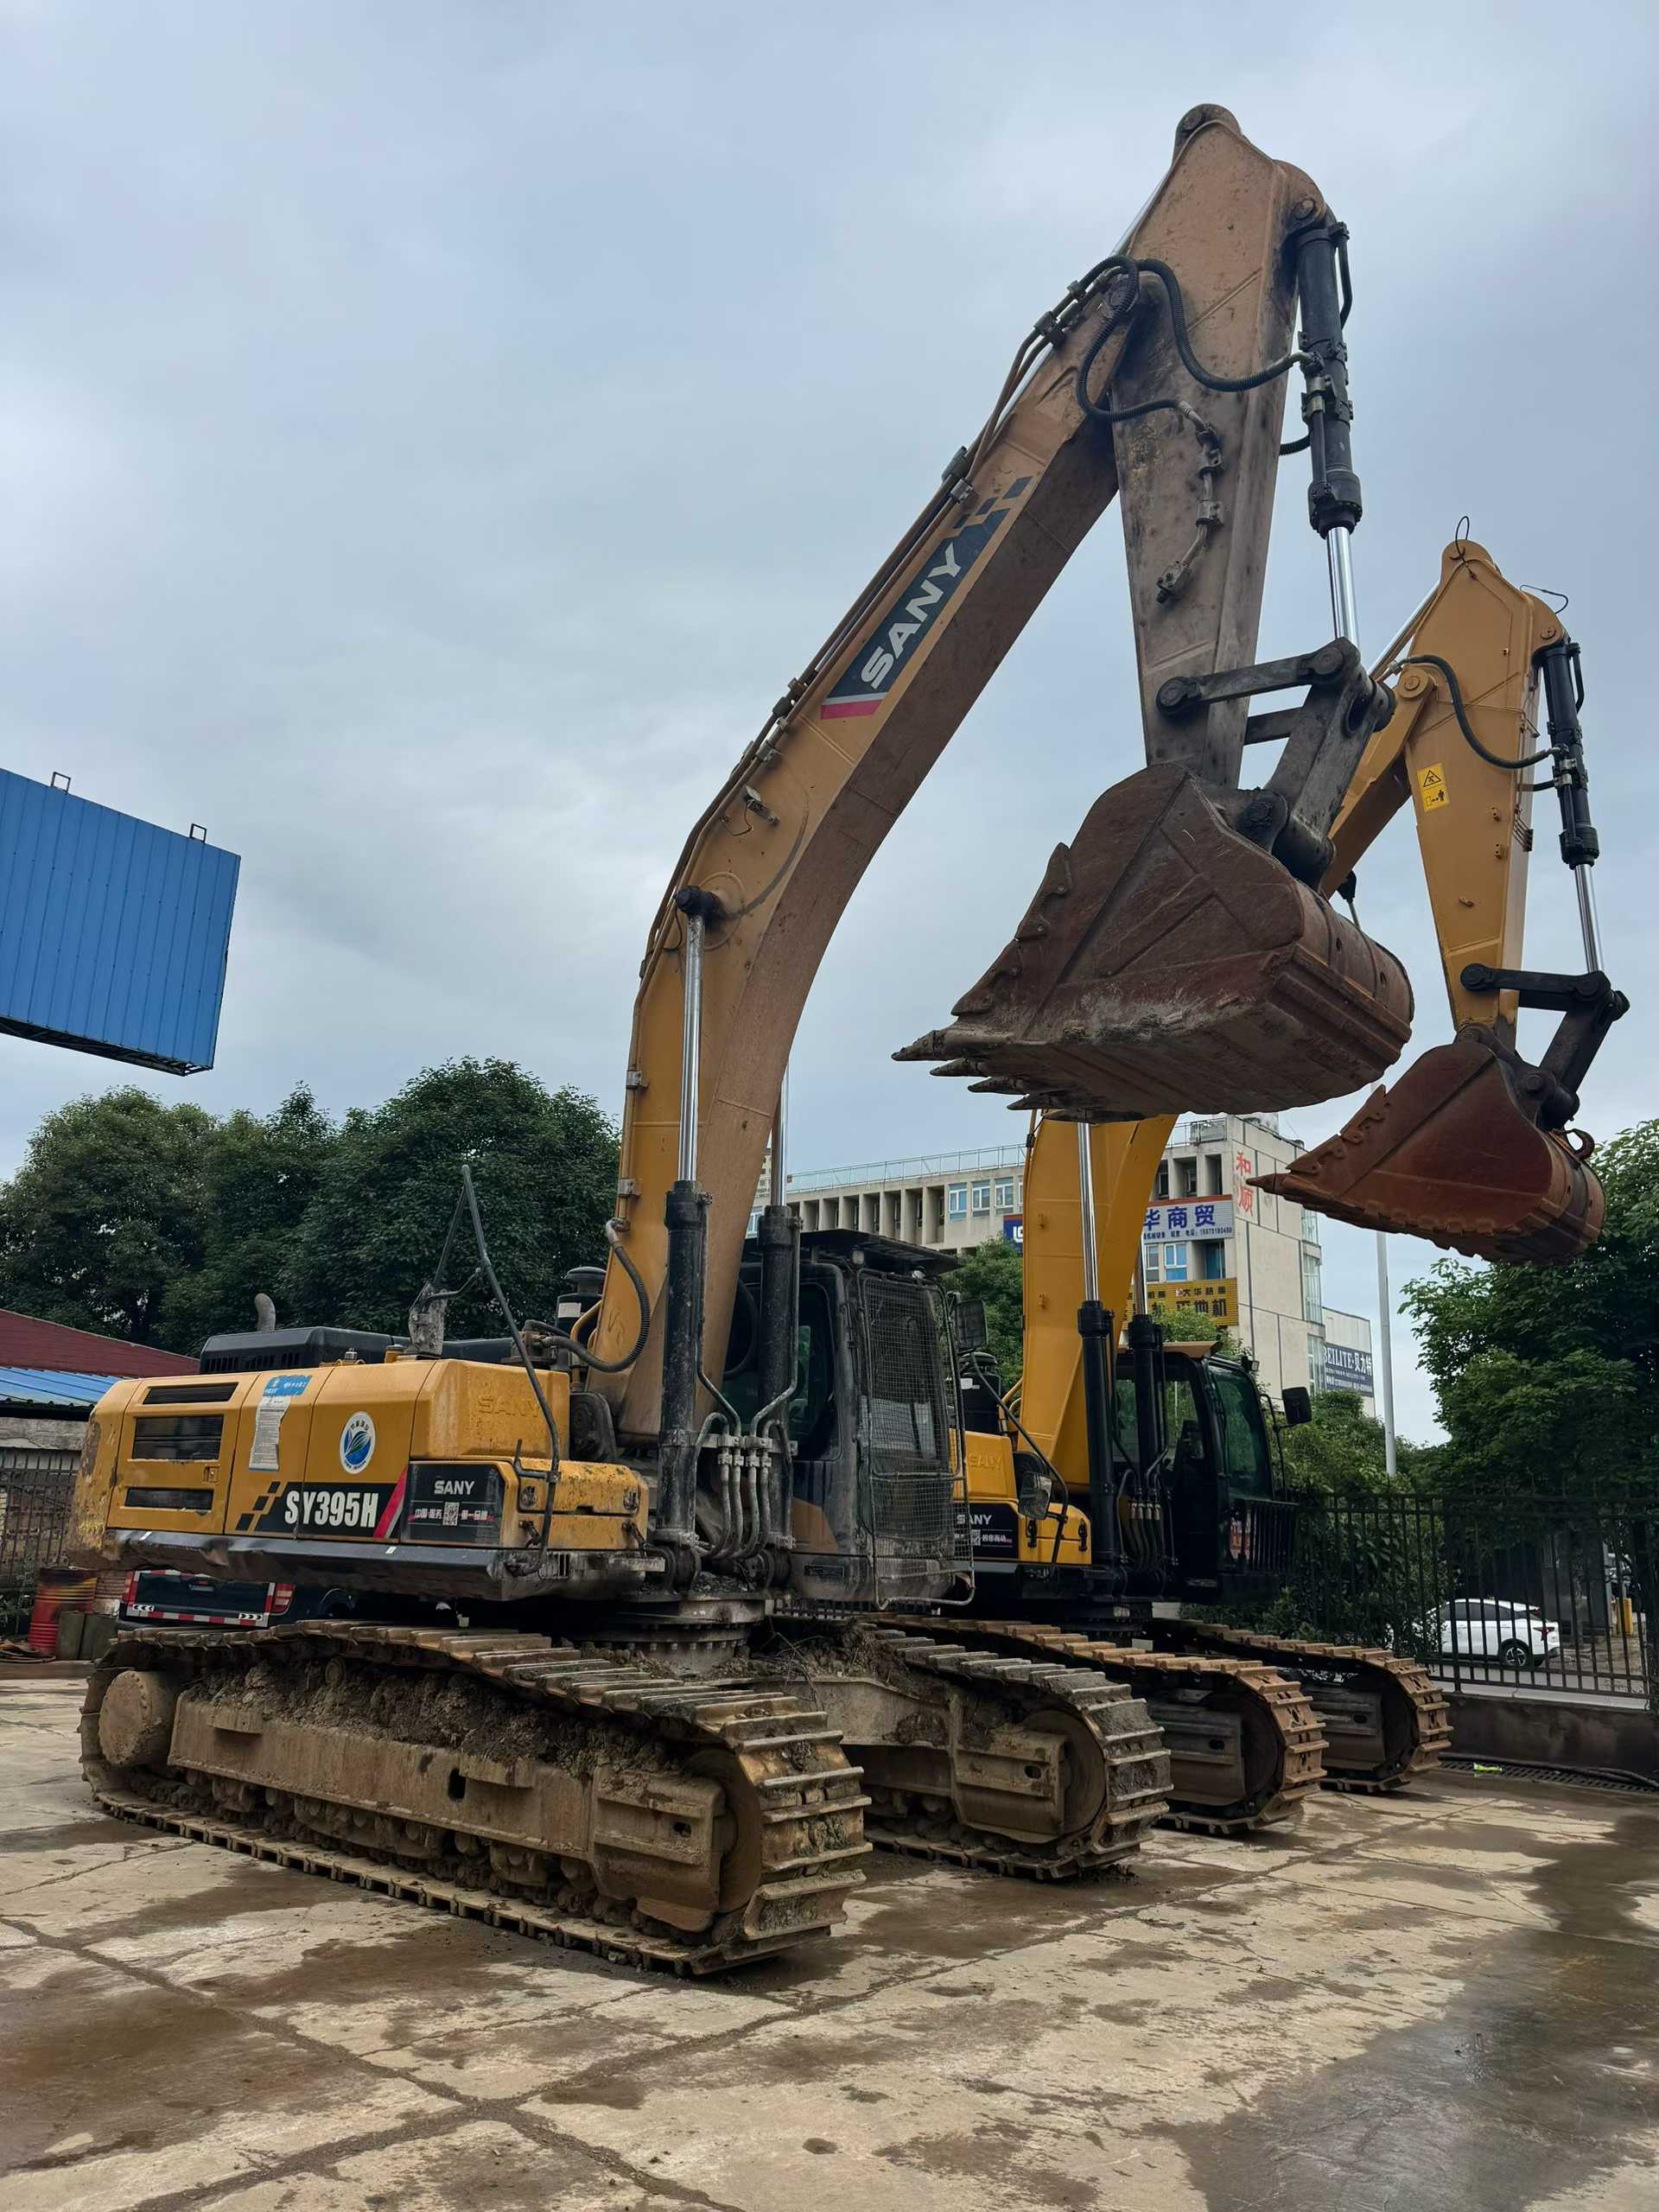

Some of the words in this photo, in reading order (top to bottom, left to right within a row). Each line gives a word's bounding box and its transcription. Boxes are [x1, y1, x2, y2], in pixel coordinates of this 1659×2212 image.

[861, 542, 962, 690] SANY
[434, 1480, 475, 1495] SANY
[284, 1490, 379, 1528] SY395H
